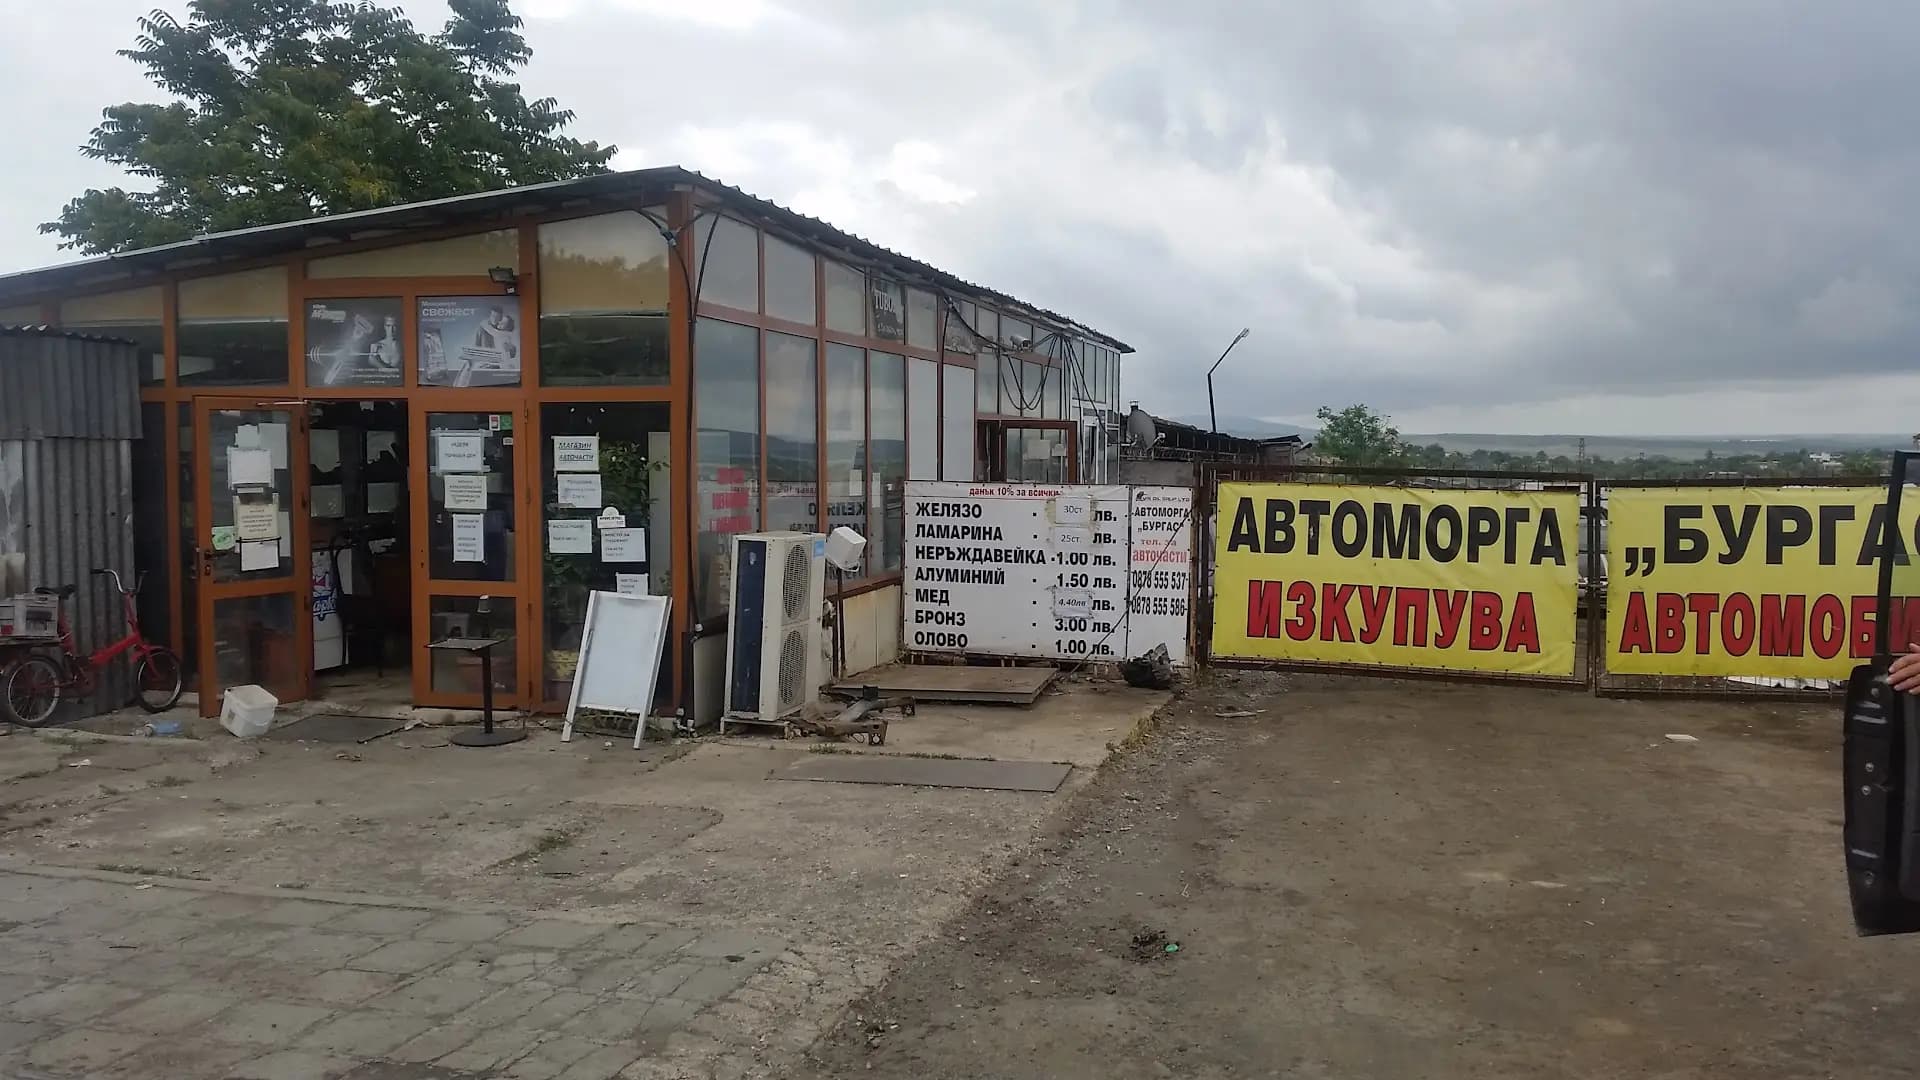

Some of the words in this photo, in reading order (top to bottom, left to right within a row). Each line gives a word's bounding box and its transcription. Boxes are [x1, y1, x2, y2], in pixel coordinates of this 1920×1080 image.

[969, 488, 994, 496] данък
[998, 487, 1014, 496] 10%
[915, 502, 982, 518] ЖЕЛЯЗО
[1094, 510, 1117, 522] лв.
[1134, 507, 1190, 518] АВТОМОРГА
[915, 524, 1003, 541] ЛАМАРИНА
[1092, 533, 1117, 544] лв.
[1227, 497, 1566, 566] АВТОМОРГА
[1625, 504, 1920, 577] „БУРГА
[915, 545, 1046, 565] НЕРЪЖДАВЕЙКА
[1057, 552, 1088, 566] 1.00
[1092, 555, 1117, 566] лв.
[1132, 549, 1187, 563] авточасти
[915, 566, 1005, 585] АЛУМИНИЙ
[1057, 573, 1089, 588] 1.50
[1092, 577, 1117, 588] лв.
[1132, 569, 1152, 589] 0878
[1154, 570, 1169, 589] 555
[1170, 572, 1187, 590] 537
[915, 588, 950, 606] МЕД
[1091, 600, 1115, 611] лв.
[1131, 596, 1151, 615] 0878
[1153, 597, 1168, 615] 555
[1170, 598, 1185, 616] 586
[915, 609, 966, 626] БРОНЗ
[1054, 619, 1087, 632] 3.00
[1091, 622, 1115, 633] лв.
[1246, 580, 1541, 653] ИЗКУПУВА
[914, 631, 968, 648] ОЛОВО
[1055, 640, 1087, 654] 1.00
[1091, 644, 1115, 655] лв.
